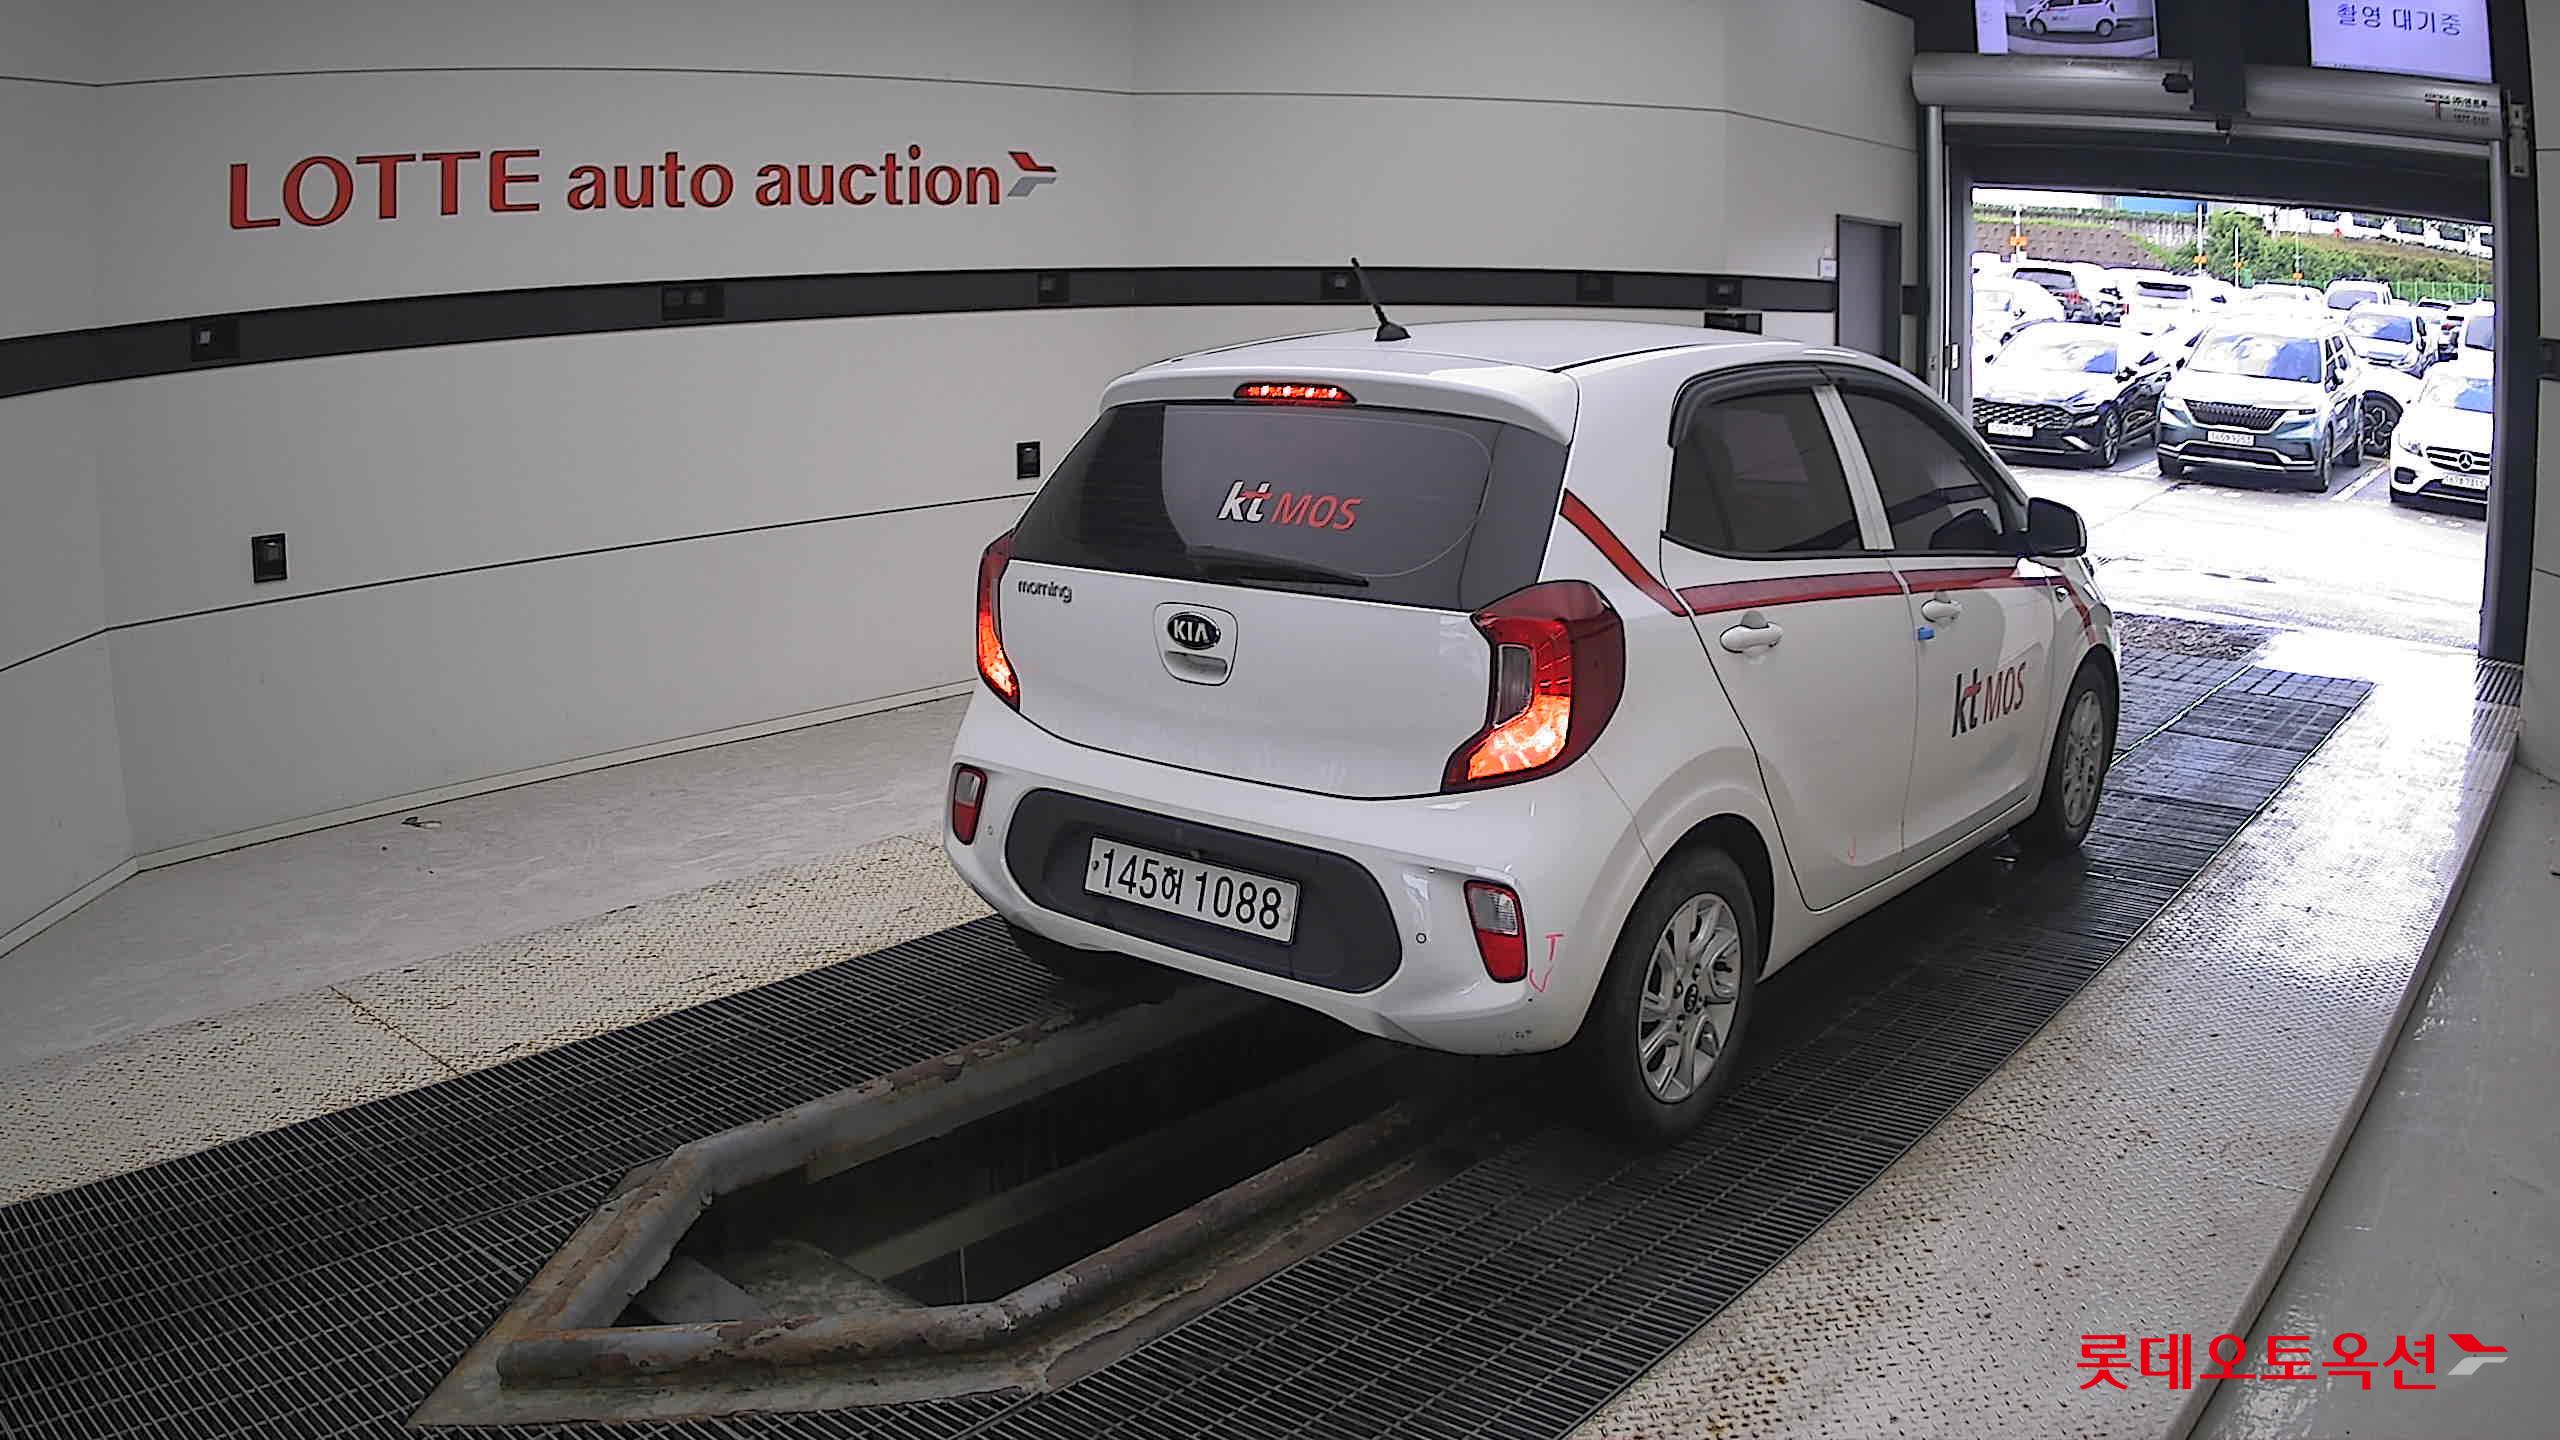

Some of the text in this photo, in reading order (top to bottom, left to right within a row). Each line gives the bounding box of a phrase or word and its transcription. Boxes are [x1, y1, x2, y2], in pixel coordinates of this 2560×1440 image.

[2337, 3, 2461, 36] 촬영 대기중
[229, 144, 1001, 230] LOTTE auto auction
[1271, 491, 1361, 531] MOS
[1017, 581, 1073, 604] morning
[1173, 619, 1209, 643] KIA
[1951, 661, 2026, 738] kt MOS
